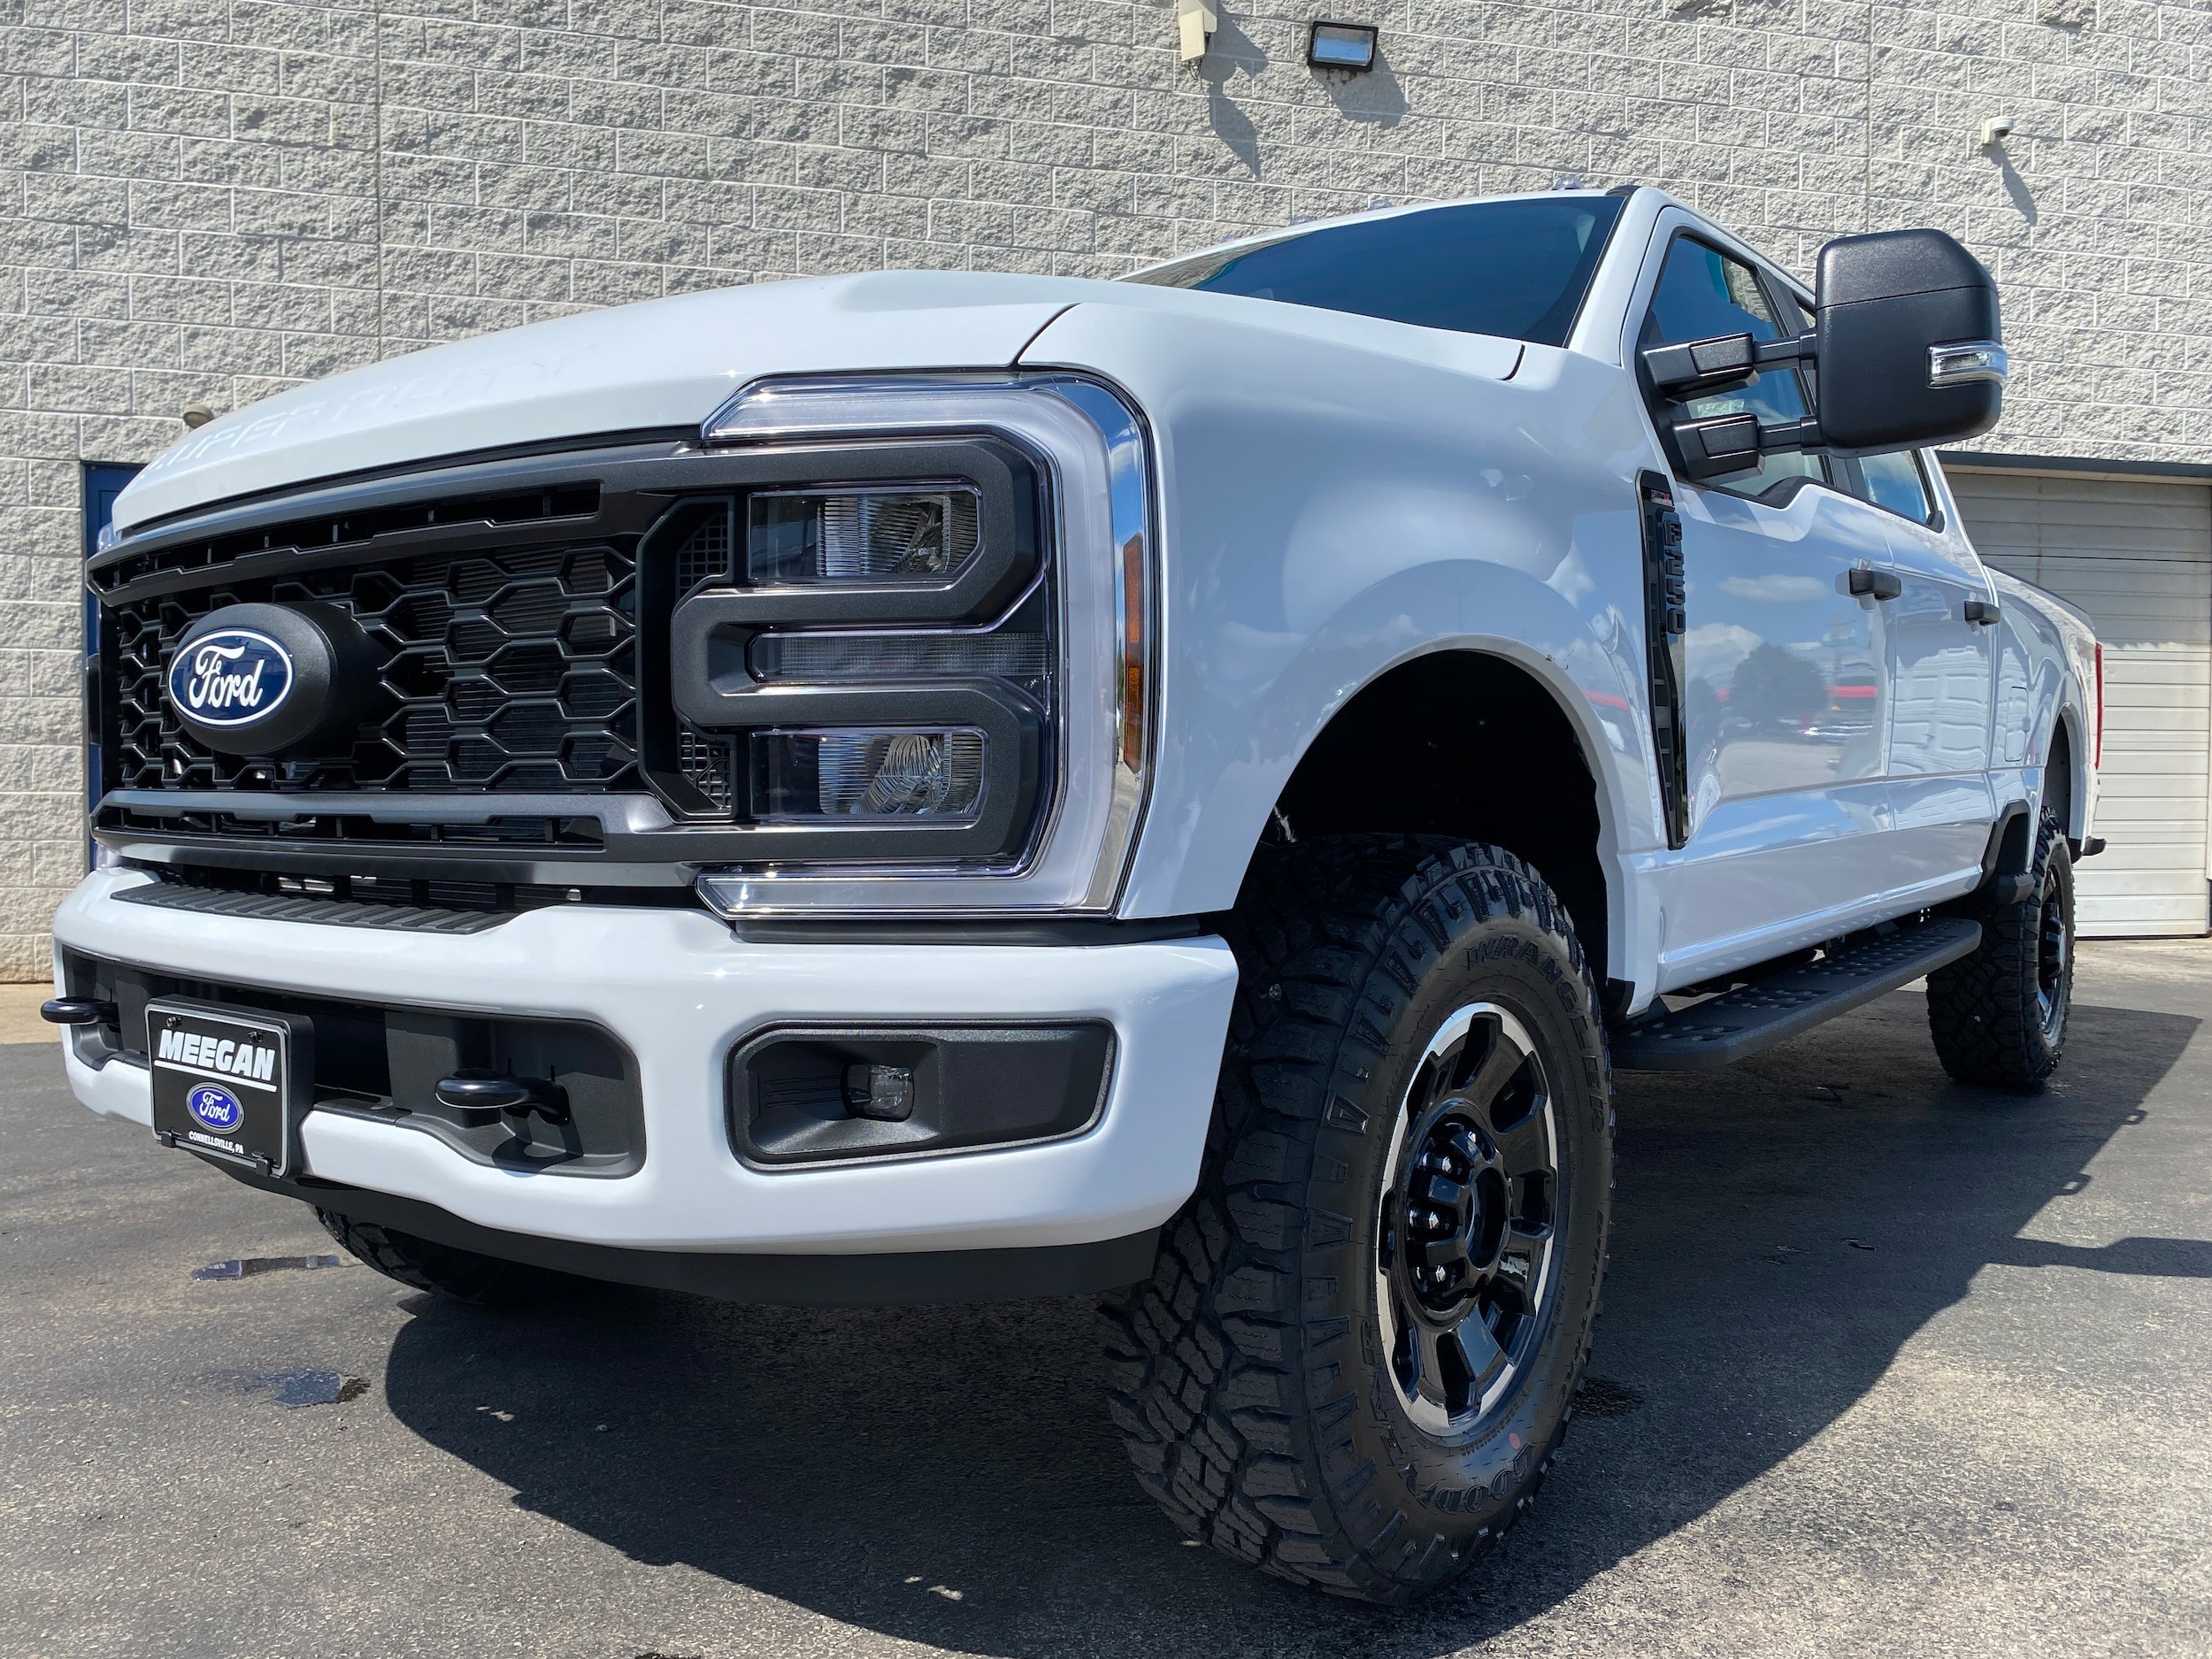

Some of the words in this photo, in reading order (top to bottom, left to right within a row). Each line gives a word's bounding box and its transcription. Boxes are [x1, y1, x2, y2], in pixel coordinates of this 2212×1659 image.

[189, 645, 265, 708] Ford
[158, 1029, 276, 1081] MEEGAN
[1464, 934, 1605, 1134] WRANGLER
[199, 1091, 231, 1123] Ford
[188, 1130, 234, 1153] CONNELLSVILLE,
[234, 1143, 244, 1155] PA
